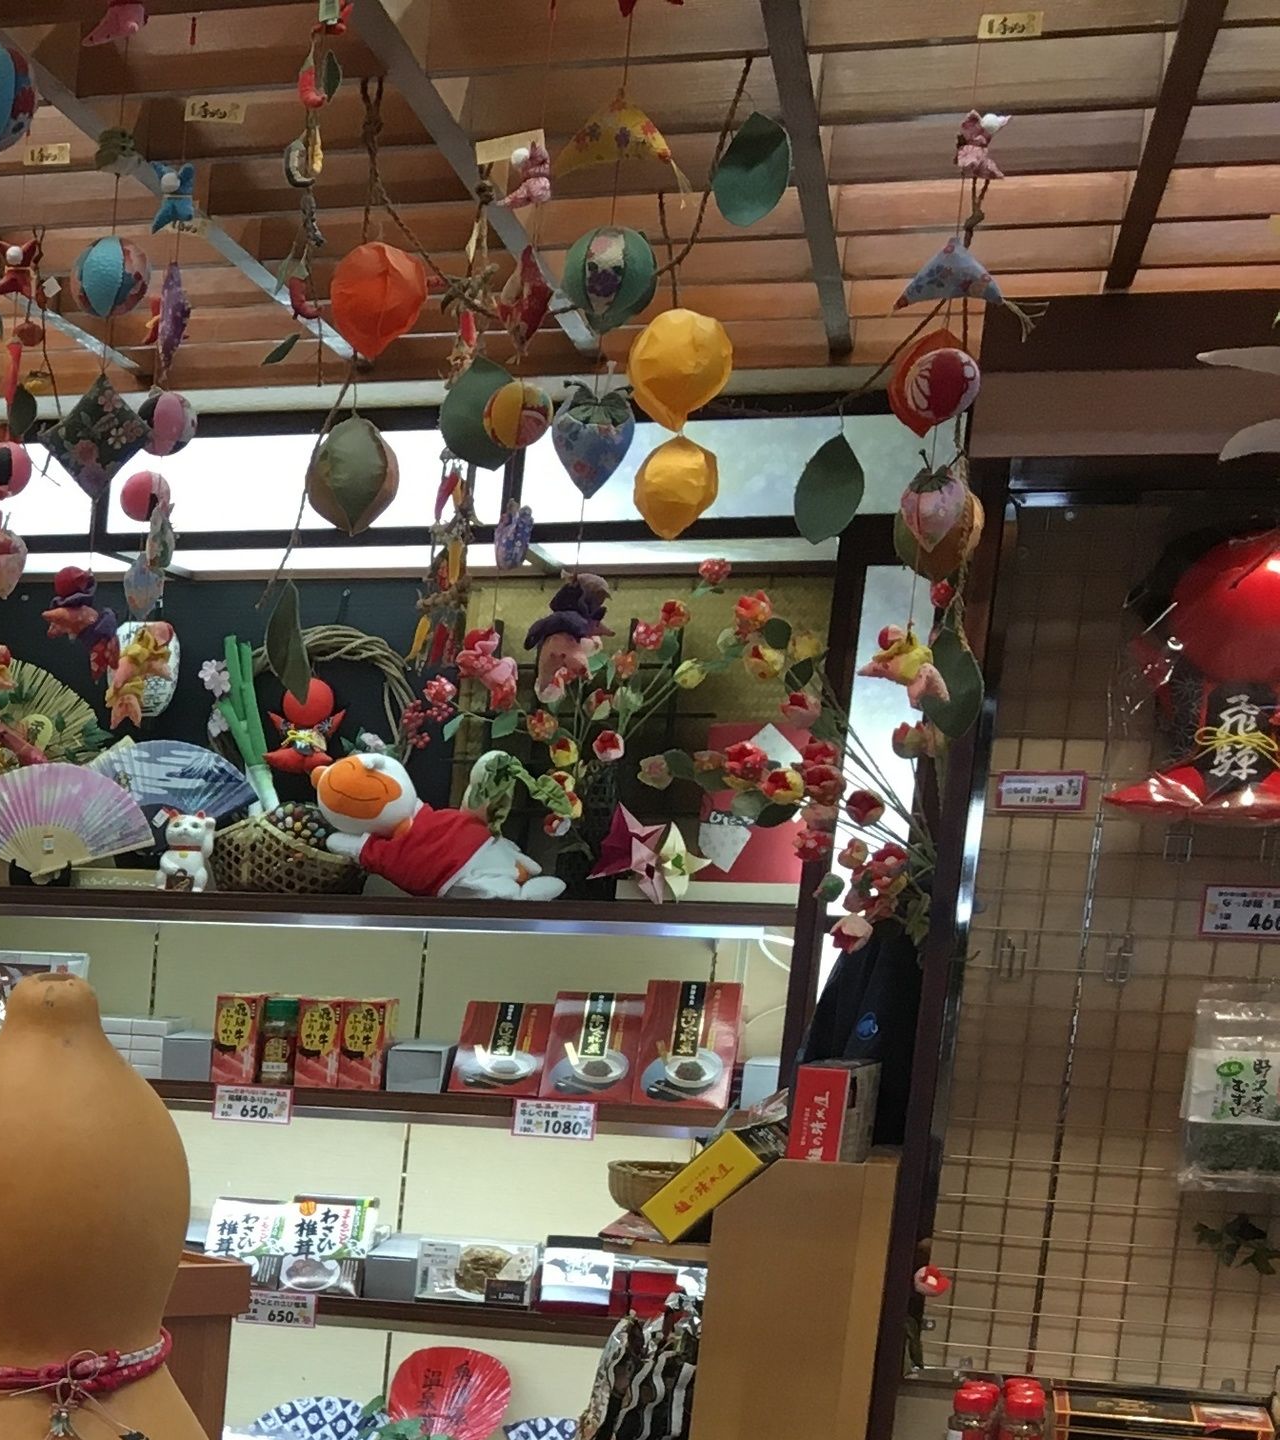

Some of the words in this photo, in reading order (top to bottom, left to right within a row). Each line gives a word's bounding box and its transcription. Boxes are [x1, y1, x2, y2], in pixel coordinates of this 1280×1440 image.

[240, 1105, 275, 1120] 650円
[542, 1118, 589, 1137] 1080円
[216, 1218, 239, 1257] 椎茸
[237, 1212, 259, 1250] わさび
[294, 1218, 318, 1260] 椎茸
[318, 1207, 339, 1252] わさび
[267, 1310, 301, 1325] 650円
